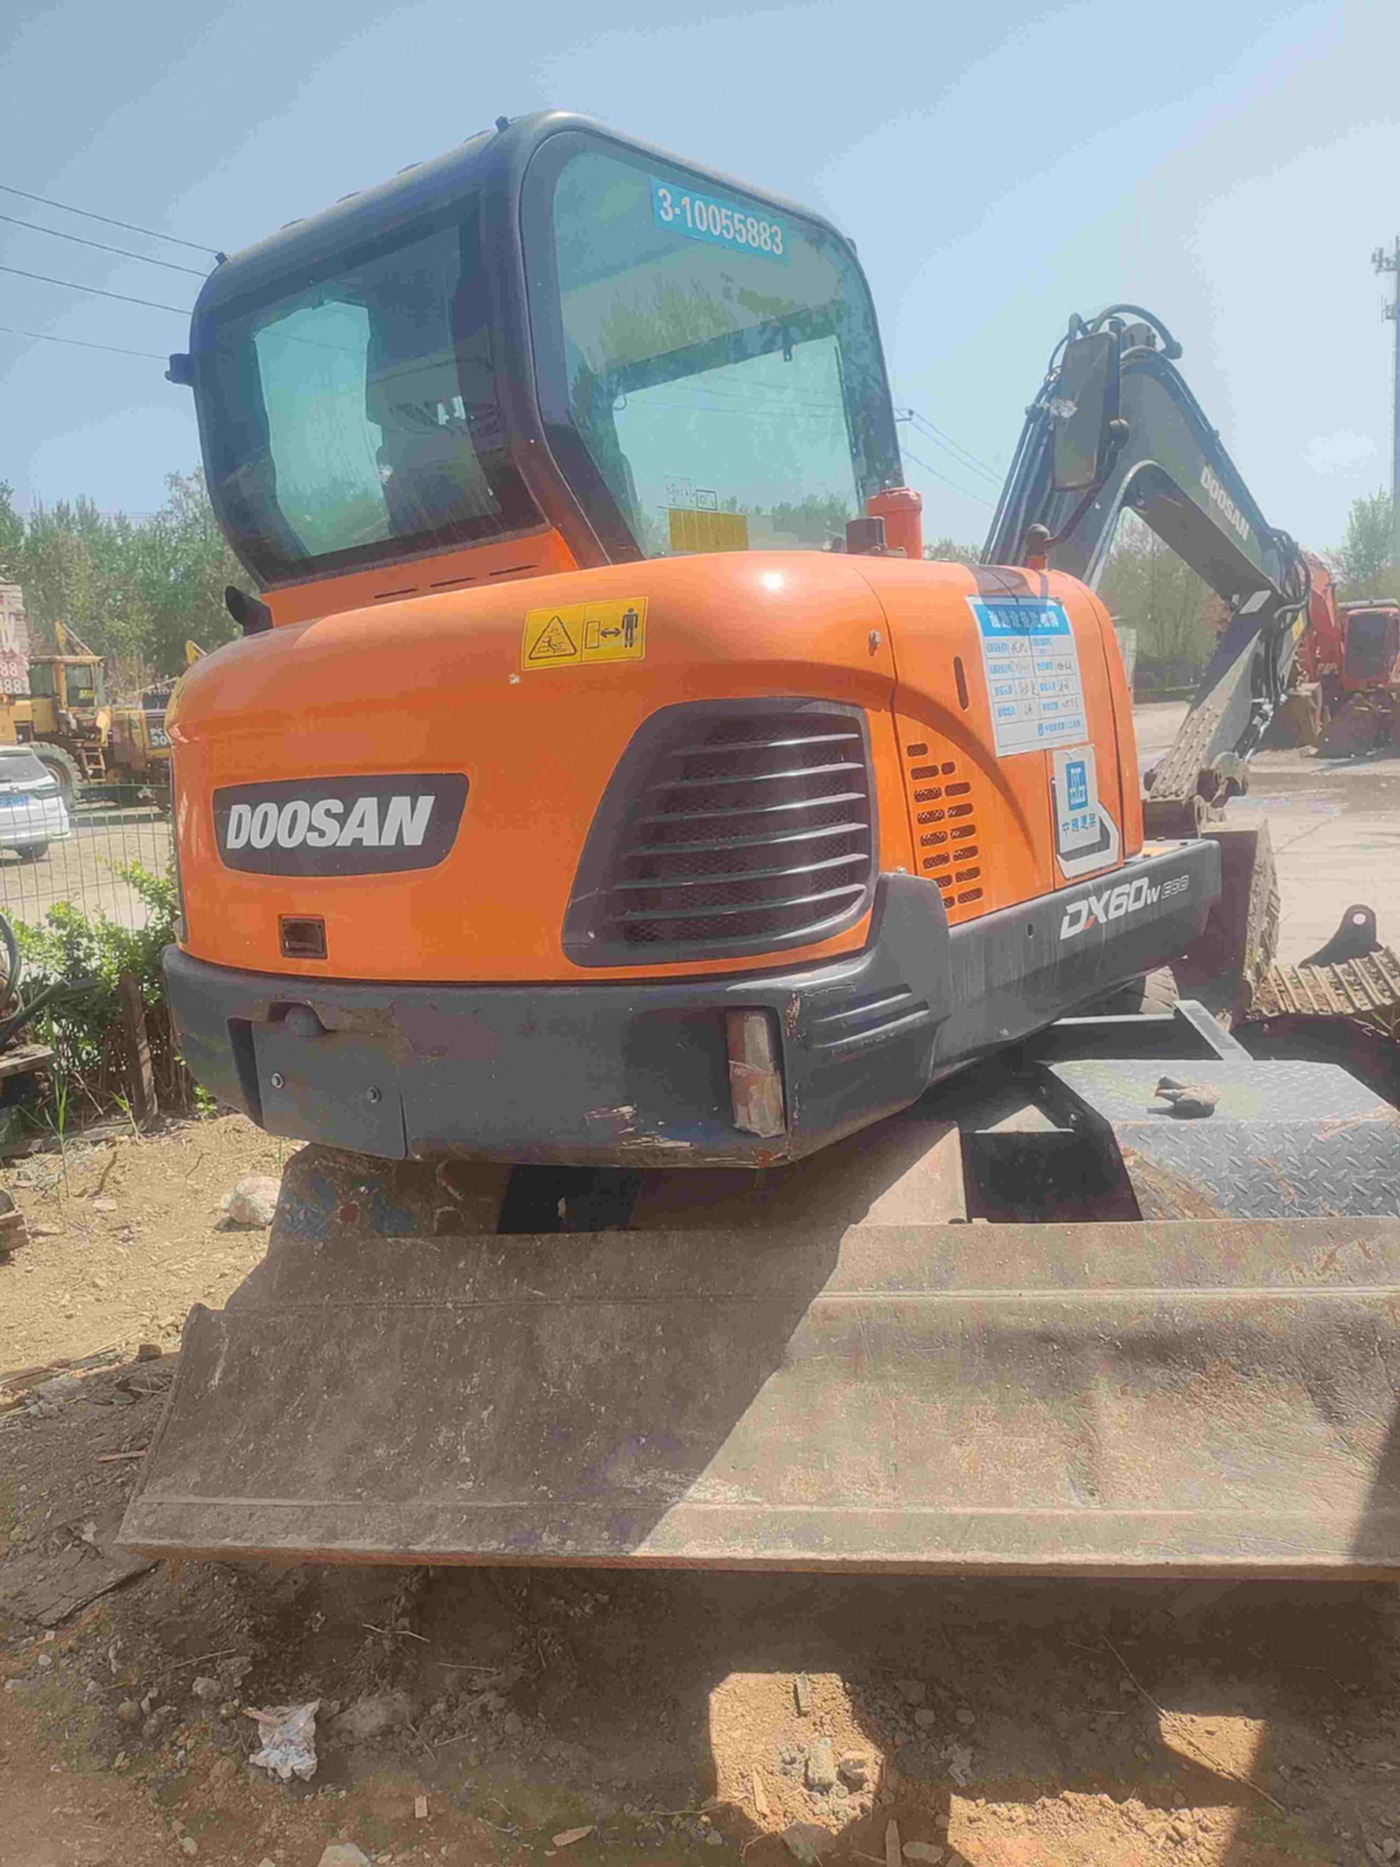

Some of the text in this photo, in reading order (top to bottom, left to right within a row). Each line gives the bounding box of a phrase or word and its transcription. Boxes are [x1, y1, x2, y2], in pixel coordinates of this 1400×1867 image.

[658, 188, 783, 255] 3-10055883
[1200, 464, 1250, 541] DOOSAN
[226, 796, 436, 849] DOOSAN
